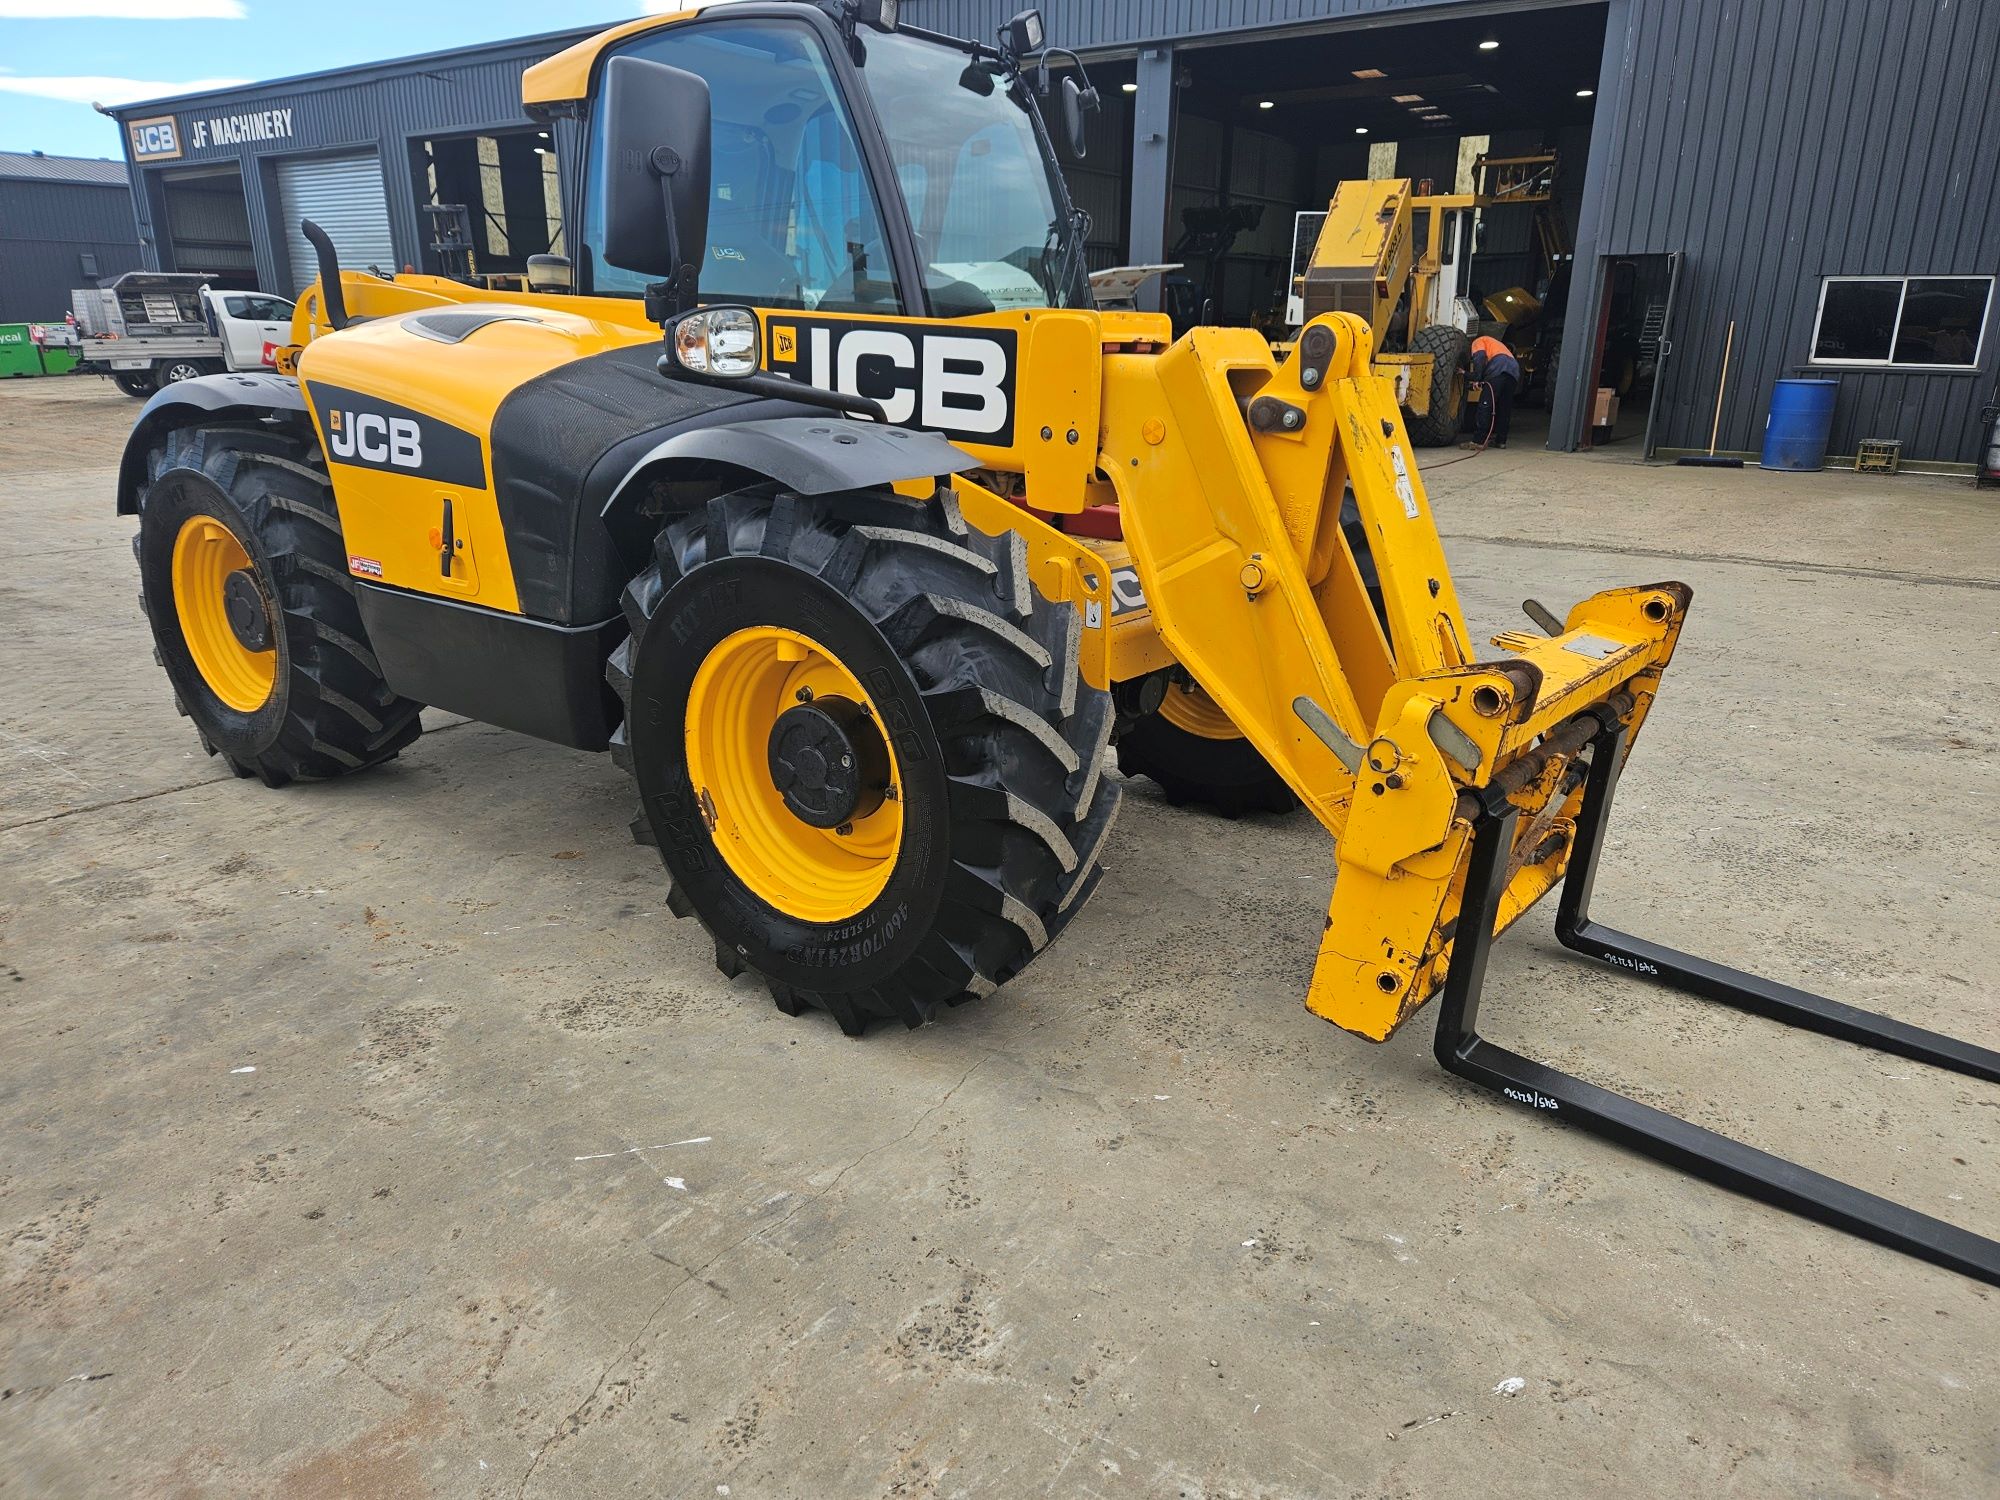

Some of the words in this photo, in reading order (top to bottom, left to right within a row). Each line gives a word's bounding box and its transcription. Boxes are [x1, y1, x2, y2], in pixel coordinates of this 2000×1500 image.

[135, 125, 175, 153] JCB
[192, 120, 208, 148] JF
[209, 108, 292, 146] MACHINERY
[778, 333, 793, 354] JCB
[331, 410, 423, 469] JCB
